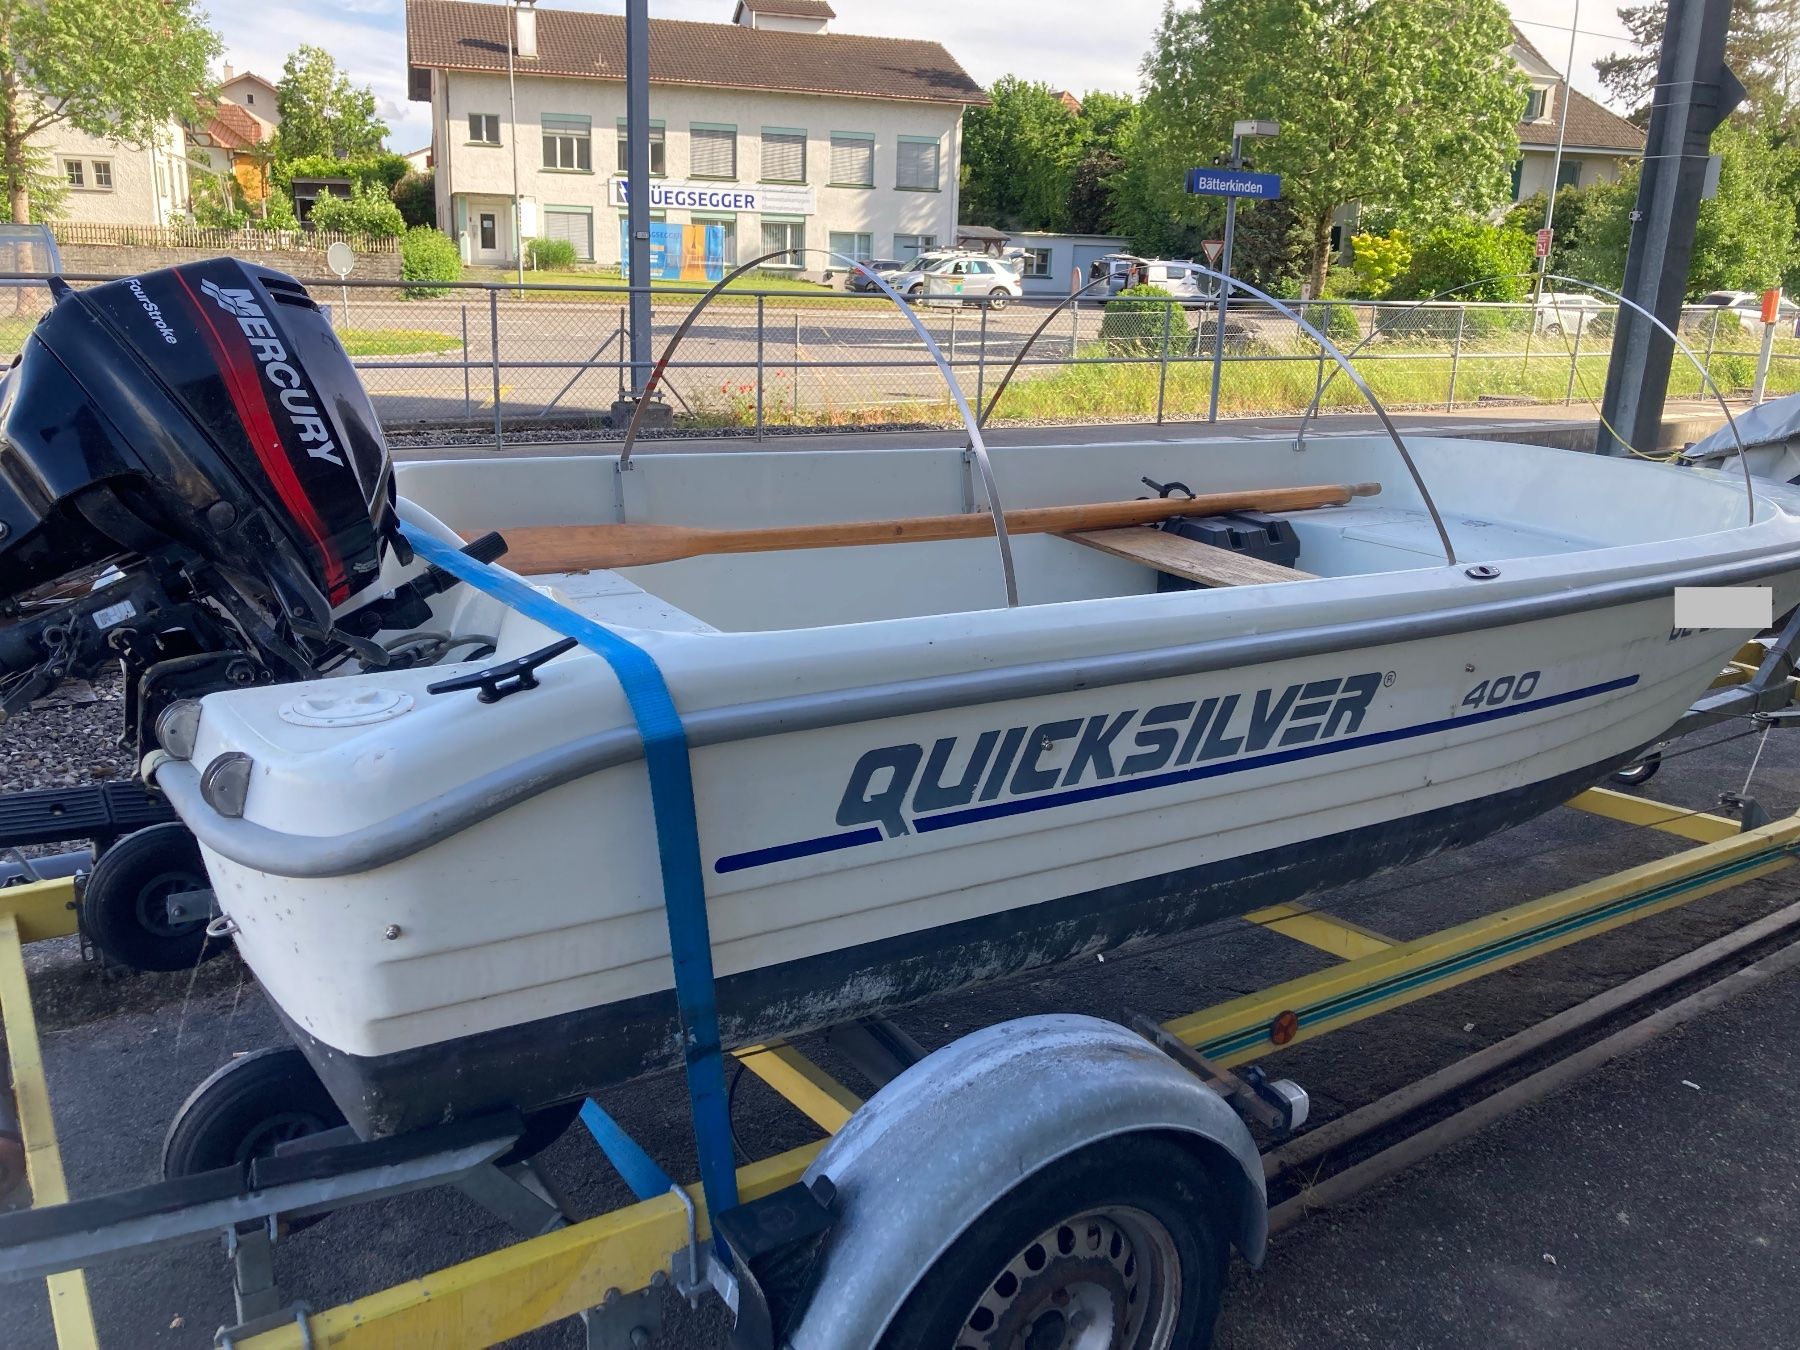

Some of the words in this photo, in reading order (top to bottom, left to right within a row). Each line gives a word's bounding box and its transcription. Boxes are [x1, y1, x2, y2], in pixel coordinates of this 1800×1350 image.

[651, 185, 755, 209] ÜEGSEGGER
[1199, 177, 1263, 193] Bätterkinden
[125, 279, 177, 344] FourStroke
[202, 278, 344, 467] MERCURY
[1461, 670, 1541, 709] 400
